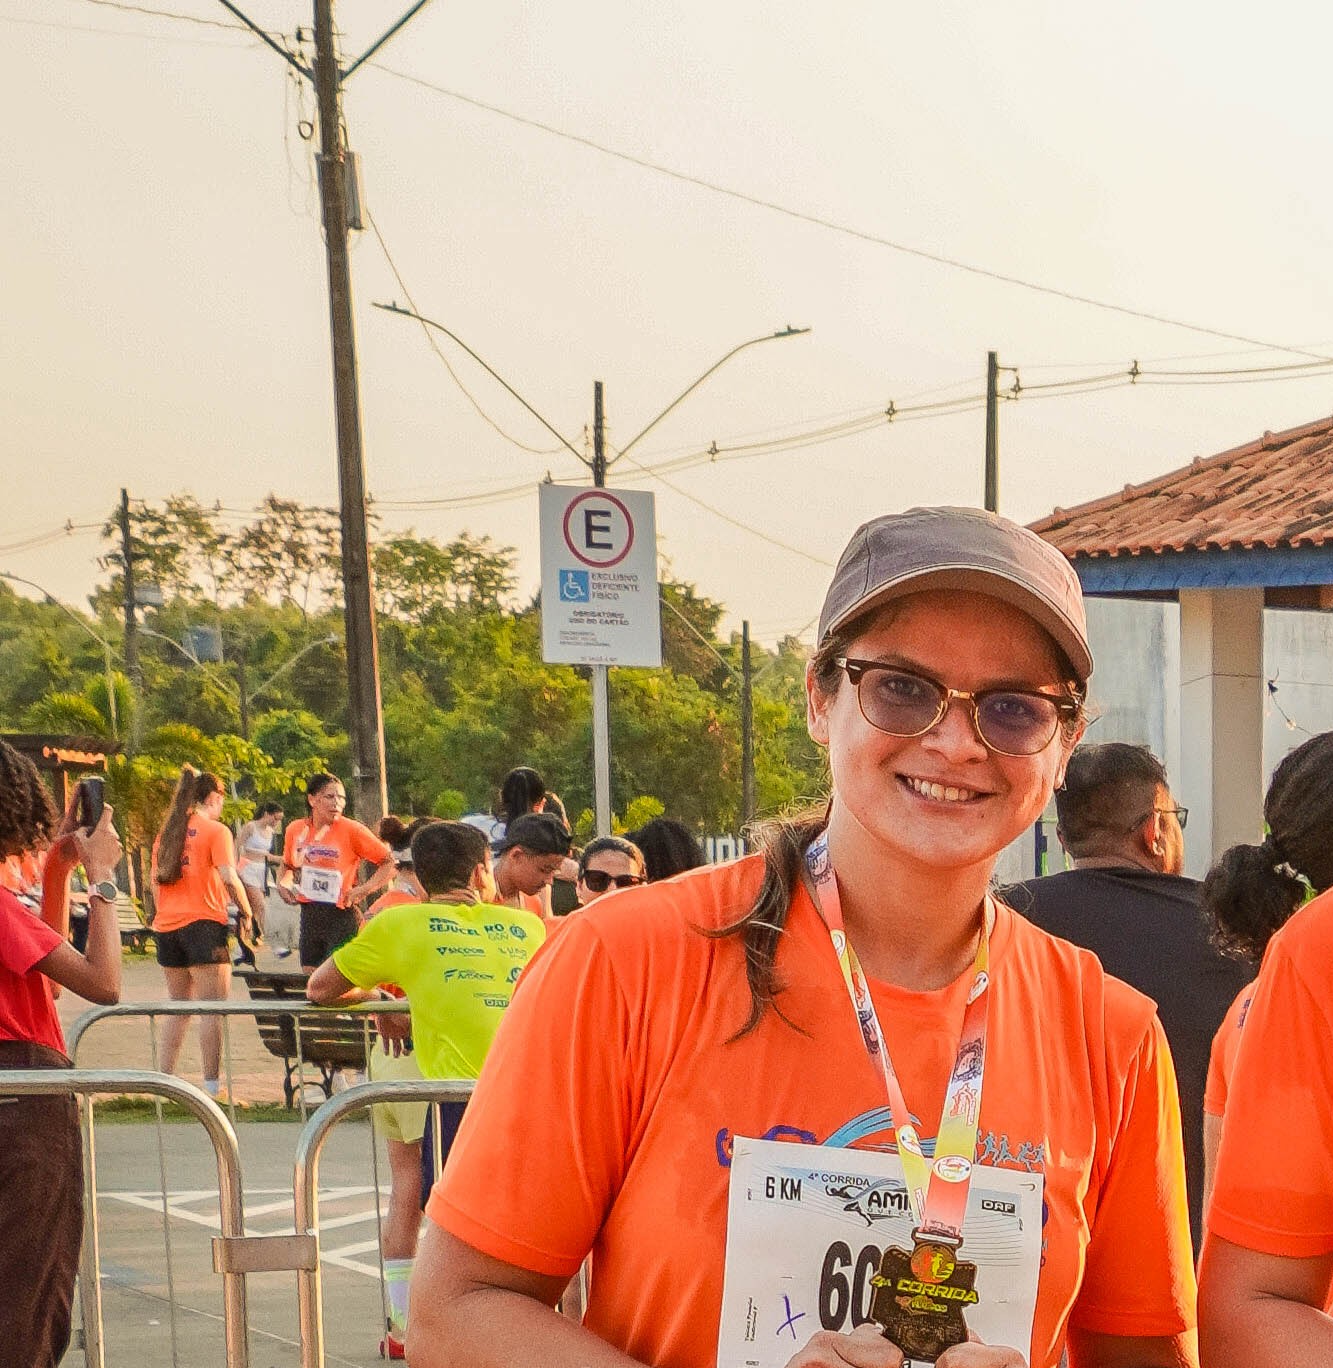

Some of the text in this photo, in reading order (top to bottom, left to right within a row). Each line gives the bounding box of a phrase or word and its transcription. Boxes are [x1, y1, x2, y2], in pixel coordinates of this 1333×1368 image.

[584, 509, 613, 550] E
[765, 1176, 801, 1201] 6 KM
[821, 1173, 872, 1188] CORRIDA
[896, 1278, 979, 1306] CORRIDA
